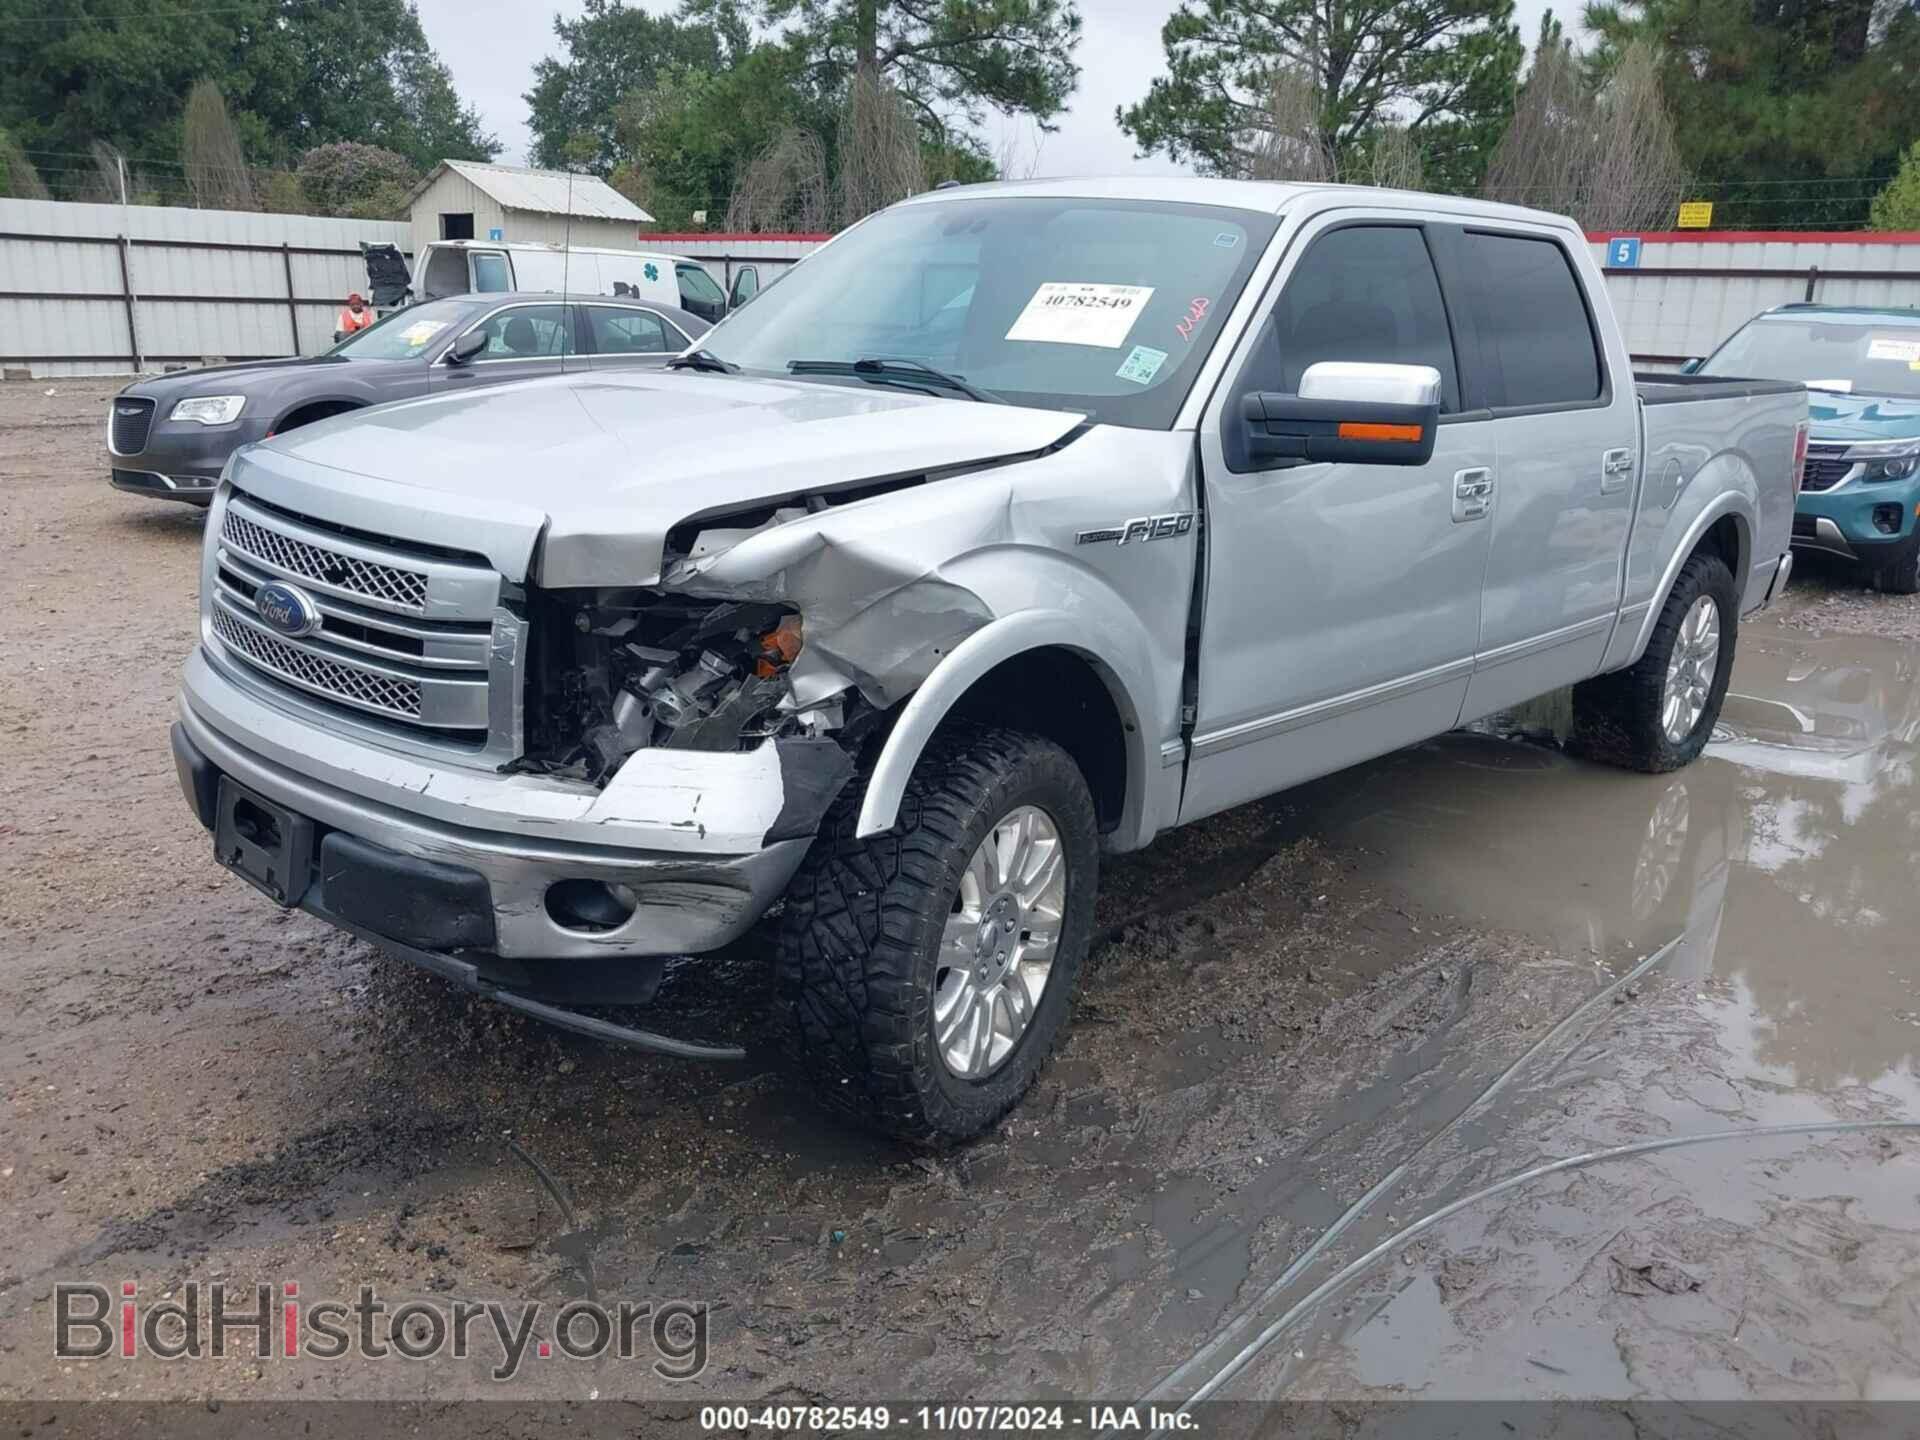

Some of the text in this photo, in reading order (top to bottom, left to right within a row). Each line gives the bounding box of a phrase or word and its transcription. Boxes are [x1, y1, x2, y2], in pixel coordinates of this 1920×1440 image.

[1618, 243, 1630, 262] 5
[1043, 294, 1132, 308] 40782549
[261, 591, 293, 624] Ford
